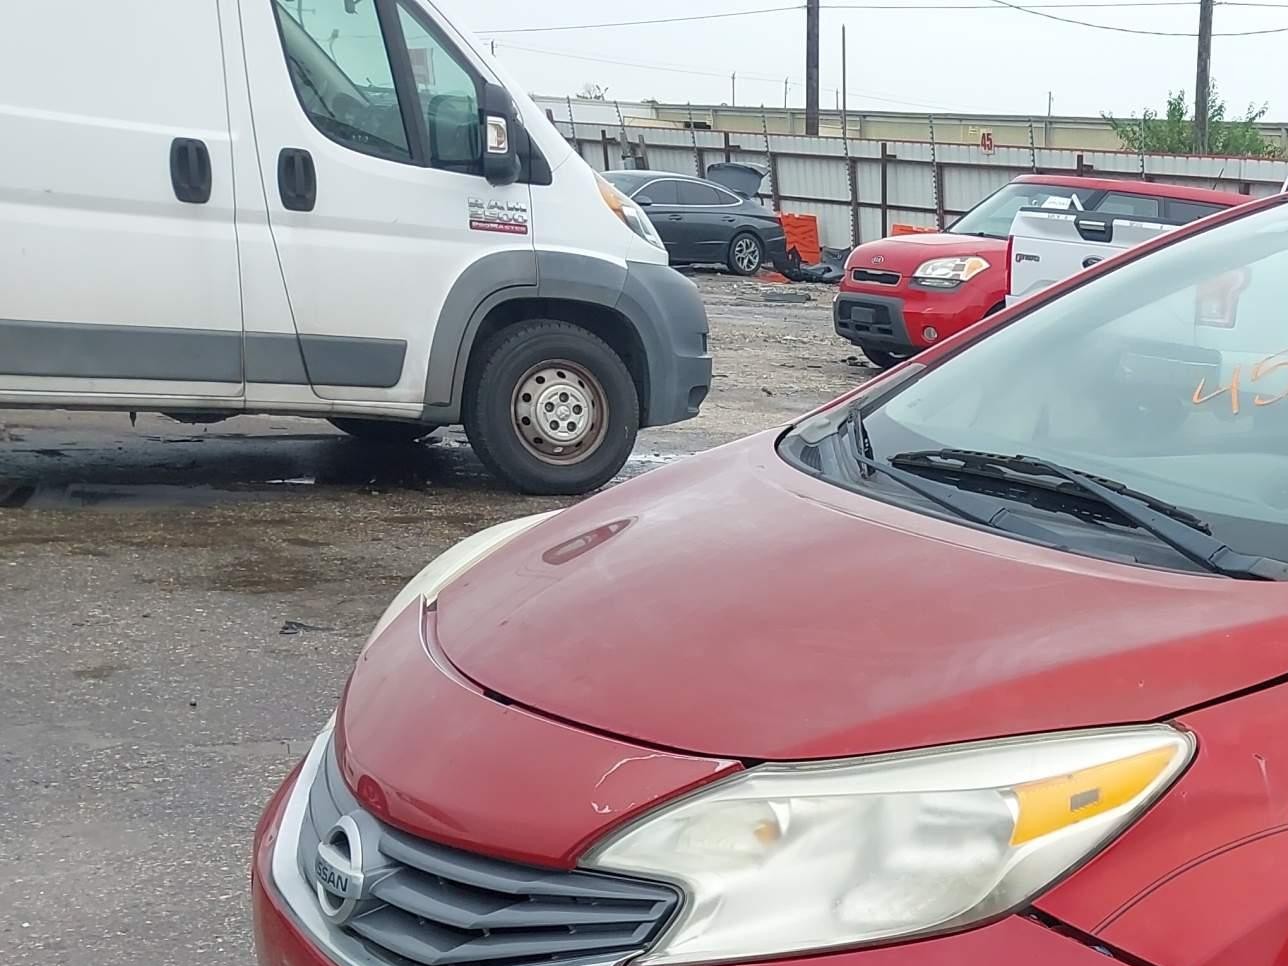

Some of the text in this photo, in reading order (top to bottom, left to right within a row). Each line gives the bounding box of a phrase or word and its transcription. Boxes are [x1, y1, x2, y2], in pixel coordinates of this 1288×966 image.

[980, 132, 993, 151] 45
[467, 197, 527, 212] RAM
[468, 210, 528, 224] 2500
[316, 861, 349, 893] SSAN
